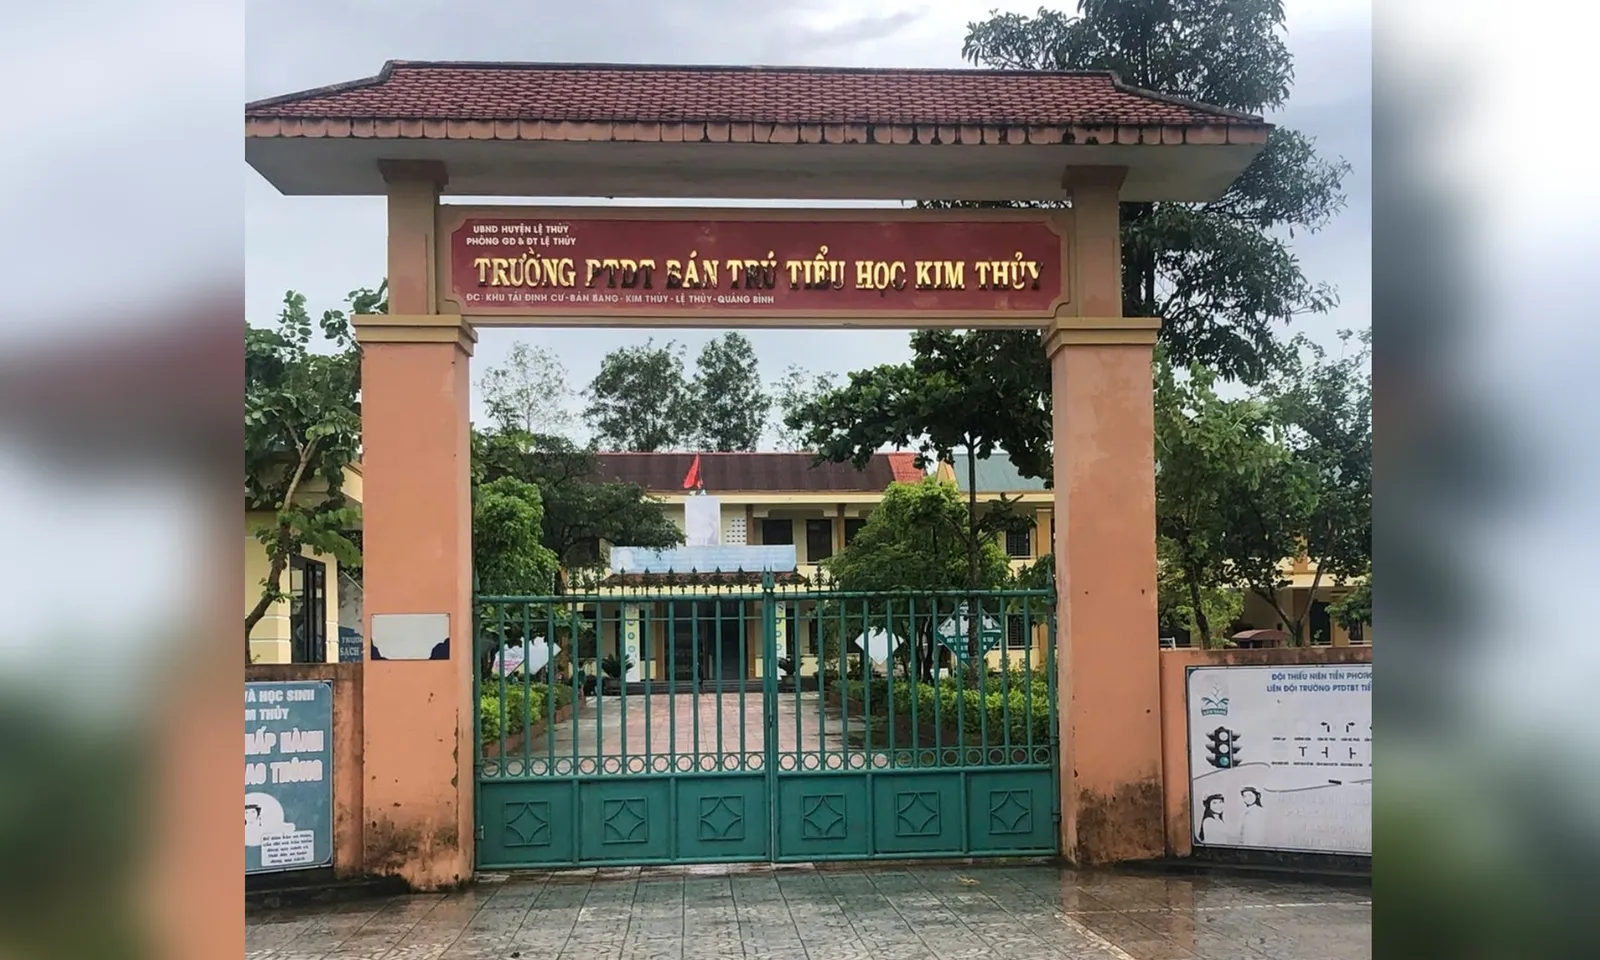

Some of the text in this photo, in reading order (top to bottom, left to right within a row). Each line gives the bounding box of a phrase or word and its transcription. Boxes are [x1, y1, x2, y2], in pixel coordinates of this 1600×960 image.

[473, 225, 499, 234] UBND
[501, 222, 532, 236] HUYỆN
[533, 222, 544, 236] LỆ
[466, 234, 500, 246] PHÒNG
[501, 237, 517, 246] GD
[517, 237, 525, 246] &
[526, 237, 539, 246] ĐT
[540, 235, 550, 248] LỆ
[474, 245, 1044, 297] TRƯỜNG PTDT BÁN TRÚ TIỂU HỌC KIM THỦY
[485, 293, 505, 302] KHU
[508, 290, 521, 302] TÁI
[524, 293, 548, 304] ĐỊNH
[592, 294, 619, 303] BANG
[625, 295, 643, 303] KIM
[675, 293, 686, 306] LỆ
[753, 293, 774, 304] BÌNH
[259, 690, 284, 704] HỌC
